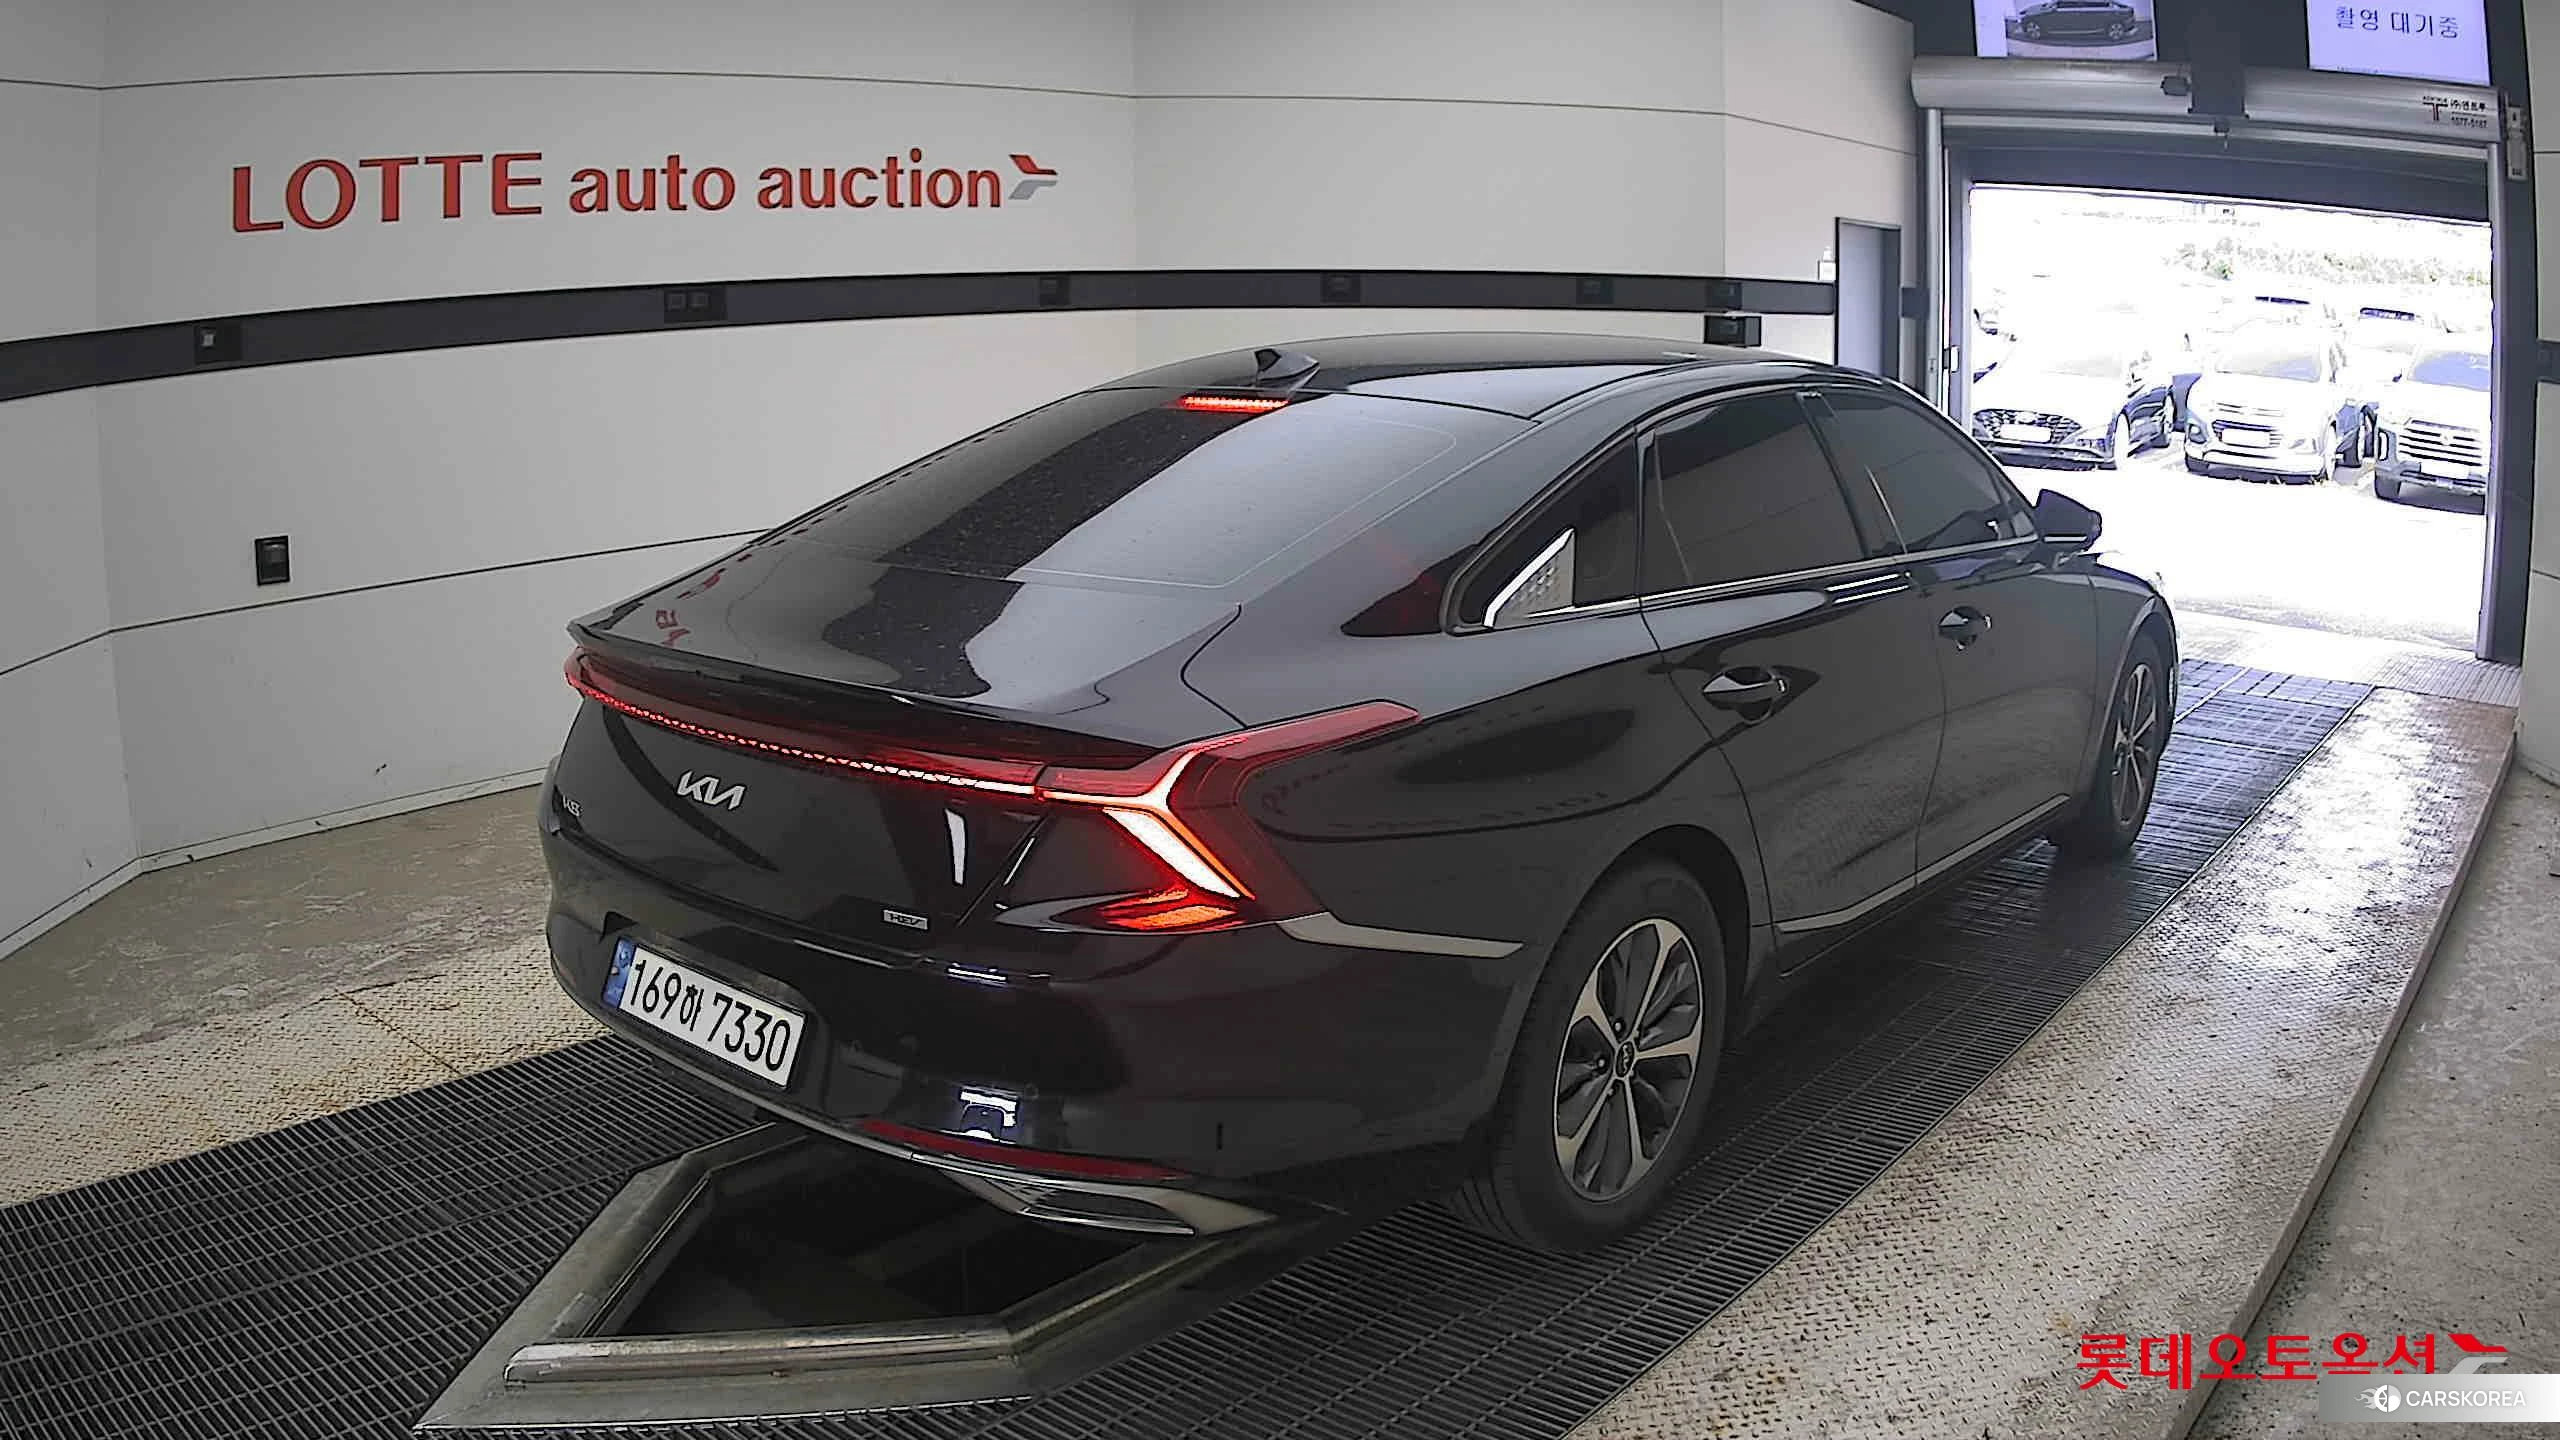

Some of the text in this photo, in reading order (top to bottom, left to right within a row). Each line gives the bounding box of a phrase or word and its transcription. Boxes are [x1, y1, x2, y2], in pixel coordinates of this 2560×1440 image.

[2336, 5, 2379, 31] 촬영
[234, 148, 1002, 232] LOTTE auto auction
[677, 770, 746, 811] KIA
[703, 991, 792, 1072] 7330
